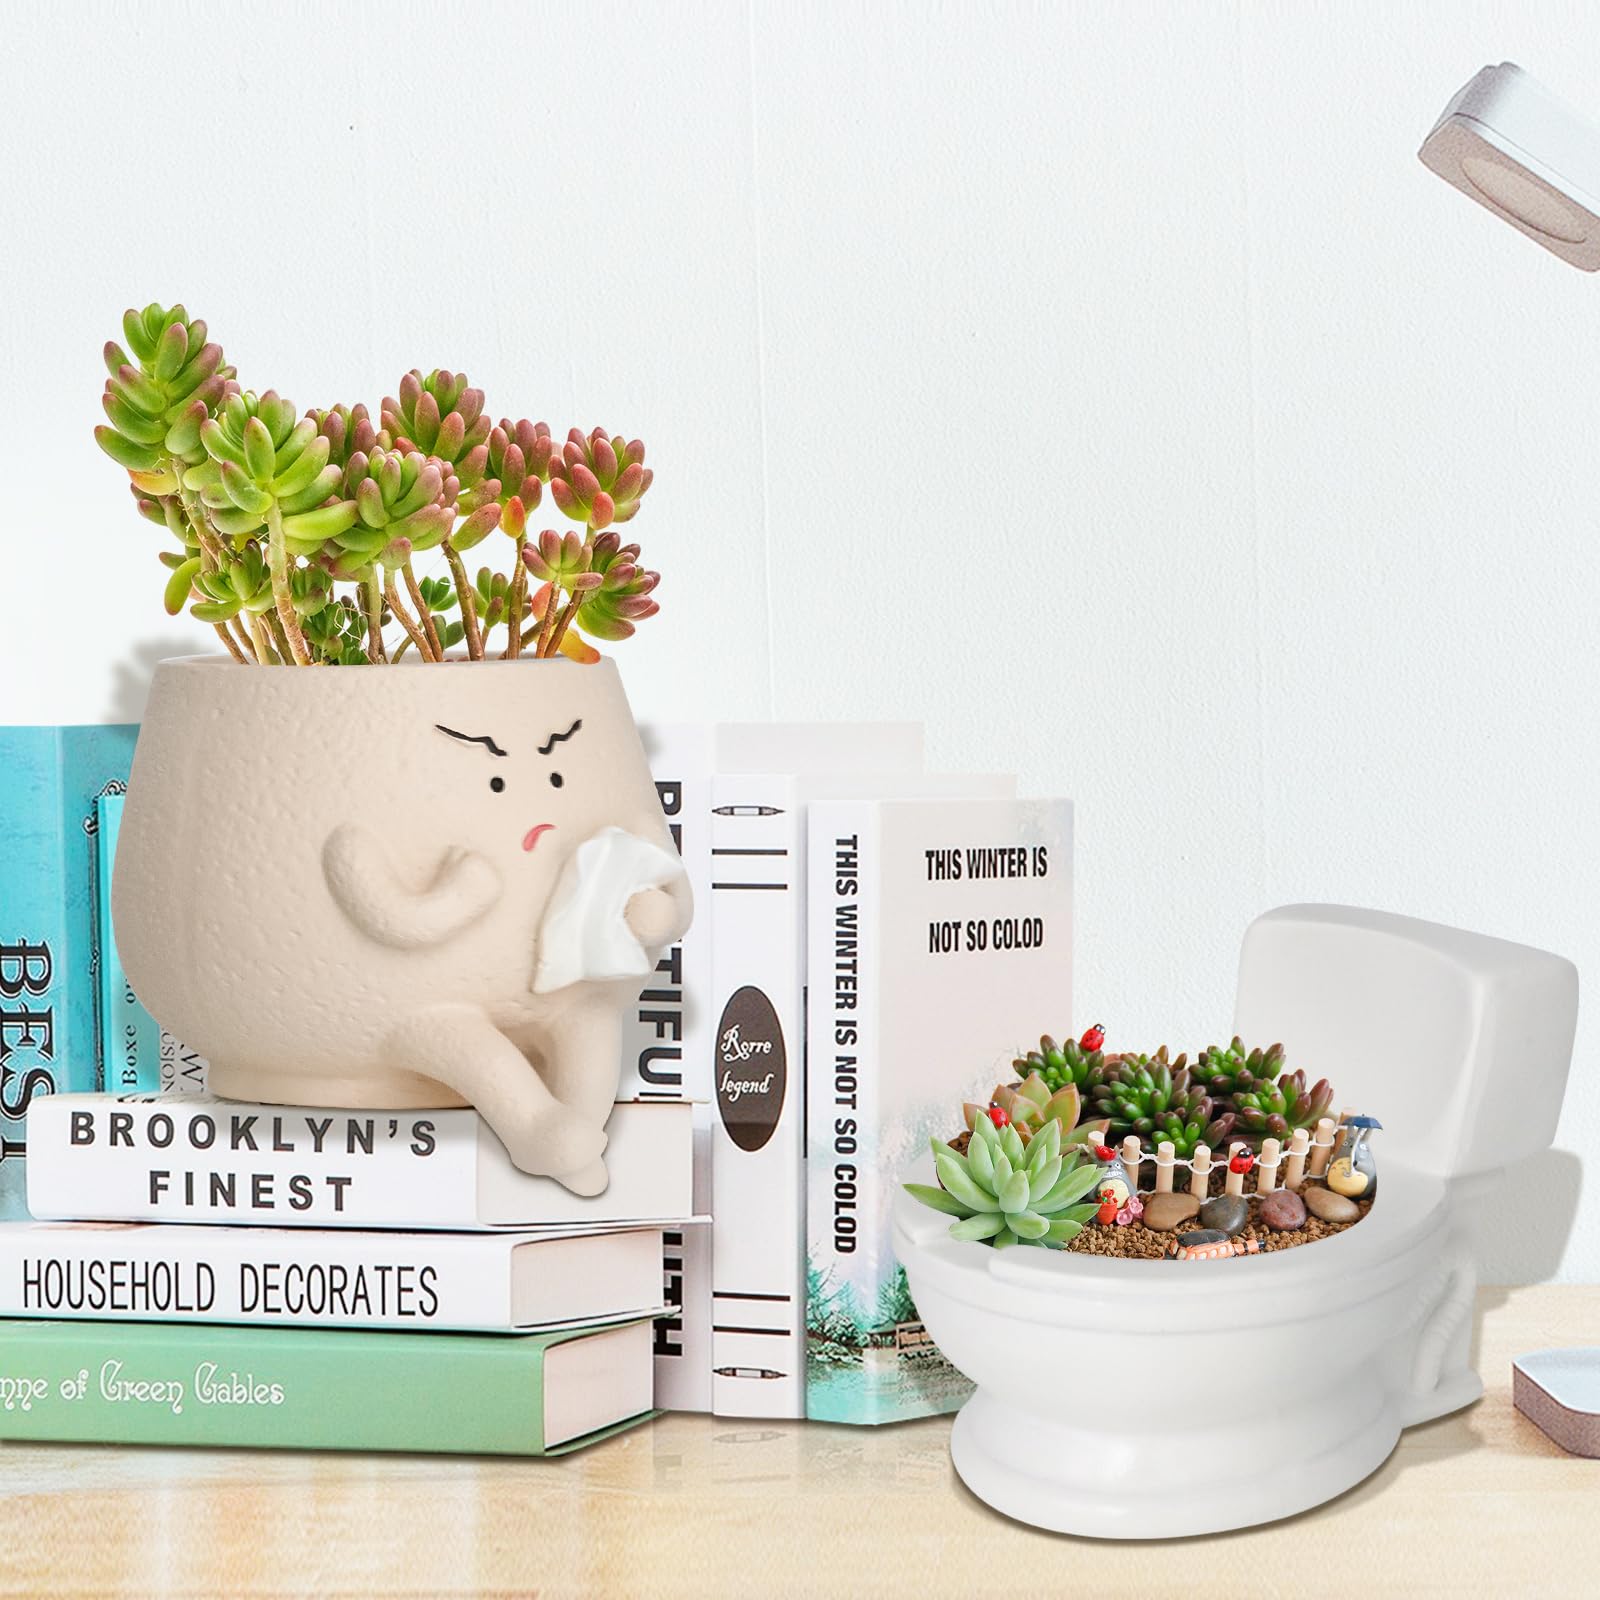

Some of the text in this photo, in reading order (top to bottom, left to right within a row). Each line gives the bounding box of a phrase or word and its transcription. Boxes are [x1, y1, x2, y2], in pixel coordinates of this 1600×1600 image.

[925, 845, 1048, 881] THIS WINTER IS
[928, 917, 1044, 954] NOT SO COLOD
[834, 834, 859, 1254] THIS WINTER IS NOT SO COLOD
[719, 1070, 775, 1102] legend
[70, 1111, 437, 1157] BROOKLYN’S
[148, 1170, 353, 1212] FINEST
[23, 1259, 439, 1318] HOUSEHOLD DECORATES
[59, 1368, 90, 1401] of
[99, 1359, 185, 1415] Green
[194, 1361, 286, 1405] Gables
